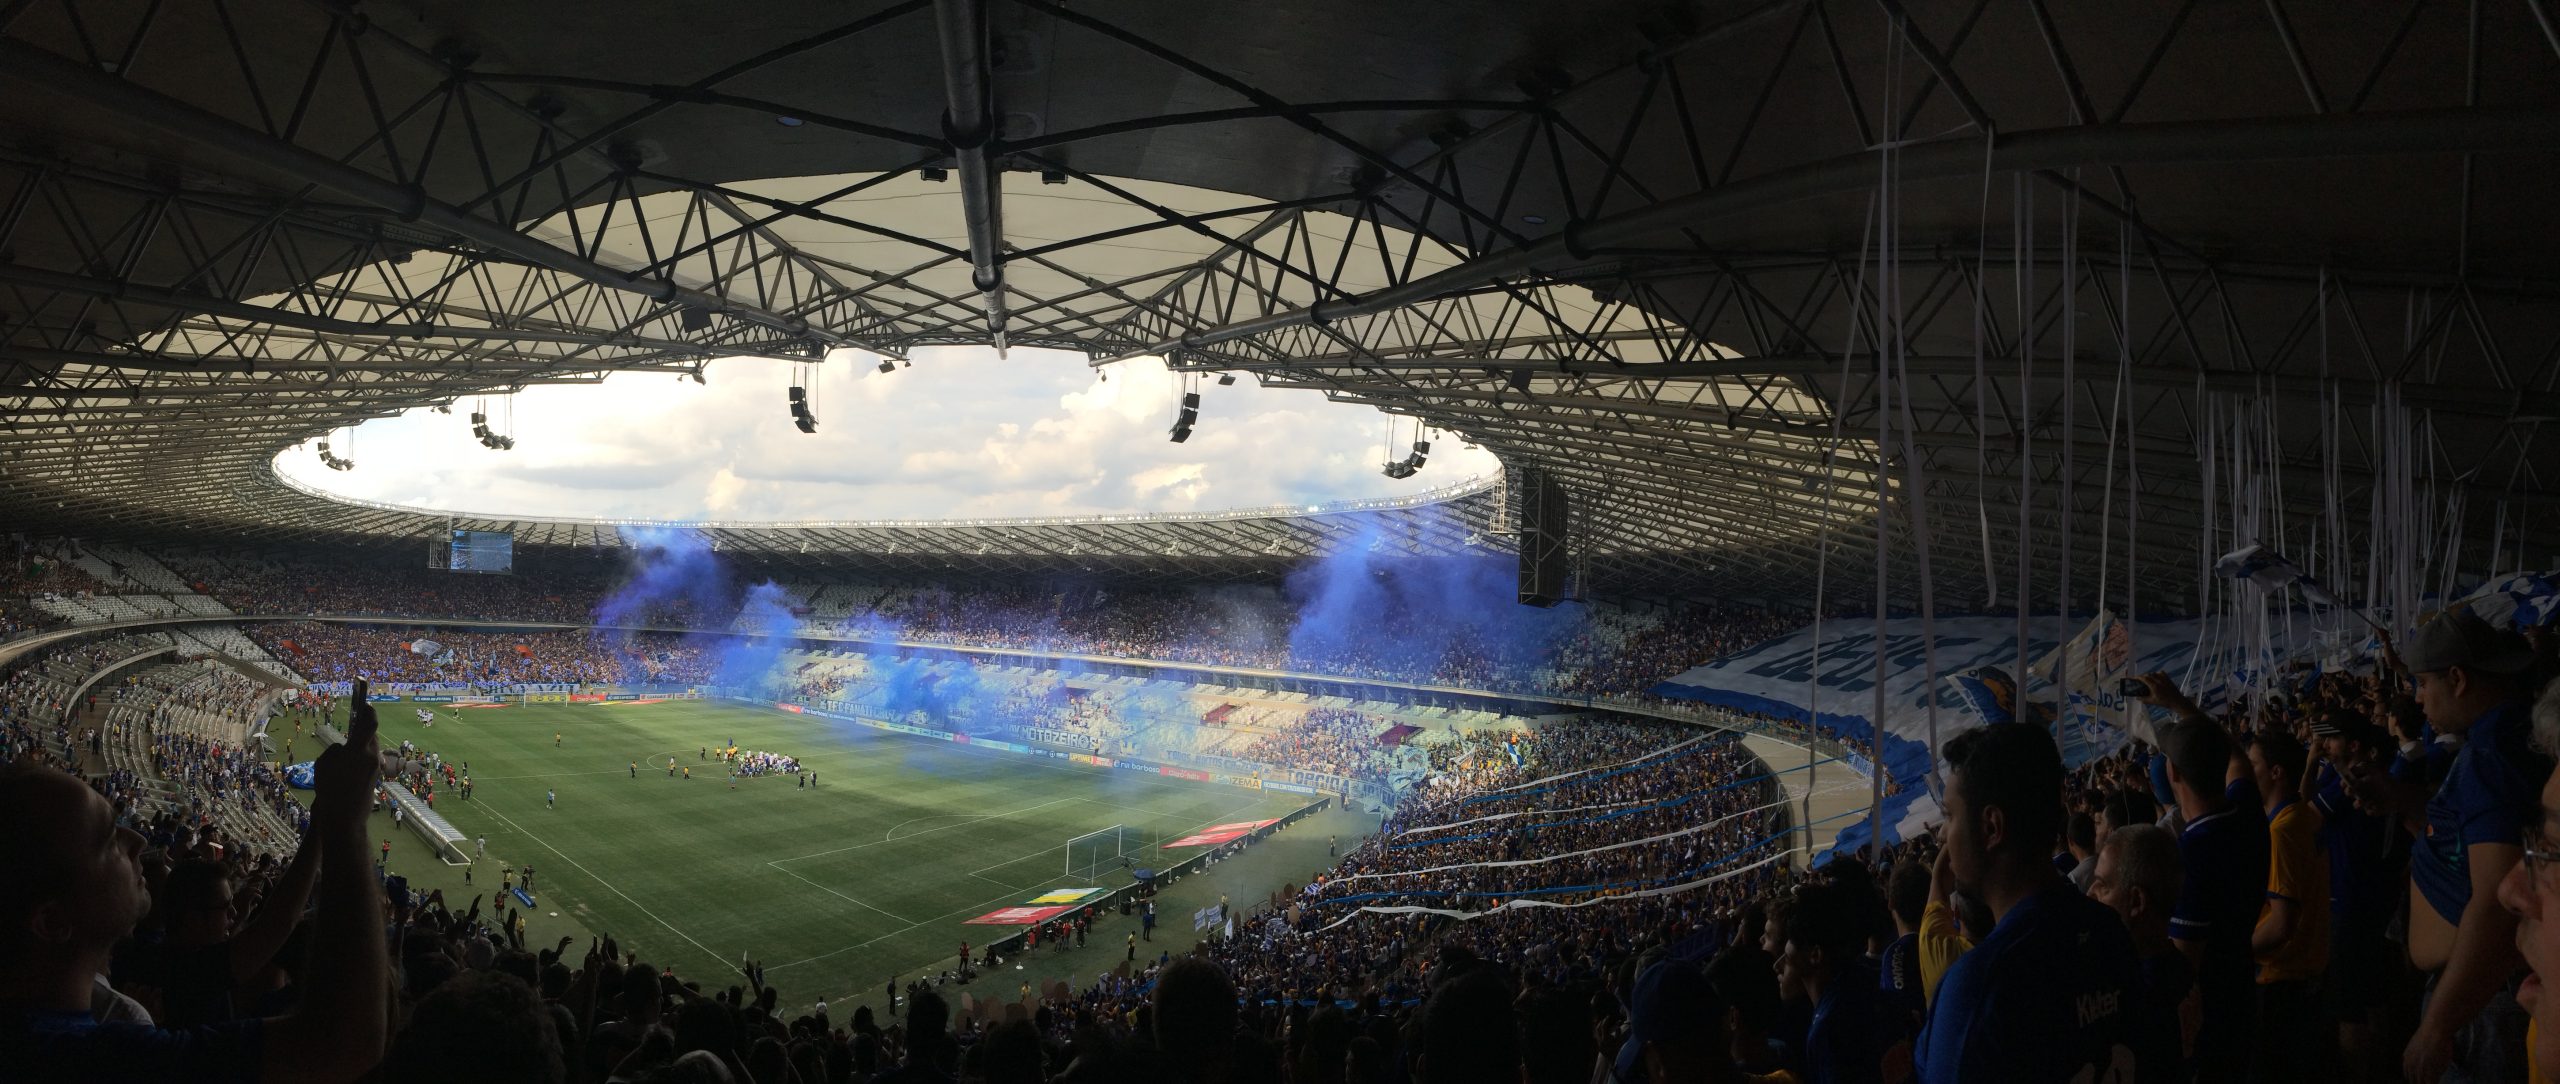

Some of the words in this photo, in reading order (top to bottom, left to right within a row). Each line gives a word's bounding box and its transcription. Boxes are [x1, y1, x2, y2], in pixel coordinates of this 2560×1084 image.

[1131, 762, 1160, 773] barbosa
[1231, 776, 1260, 788] ZEMA
[1286, 769, 1349, 794] TORCIDA
